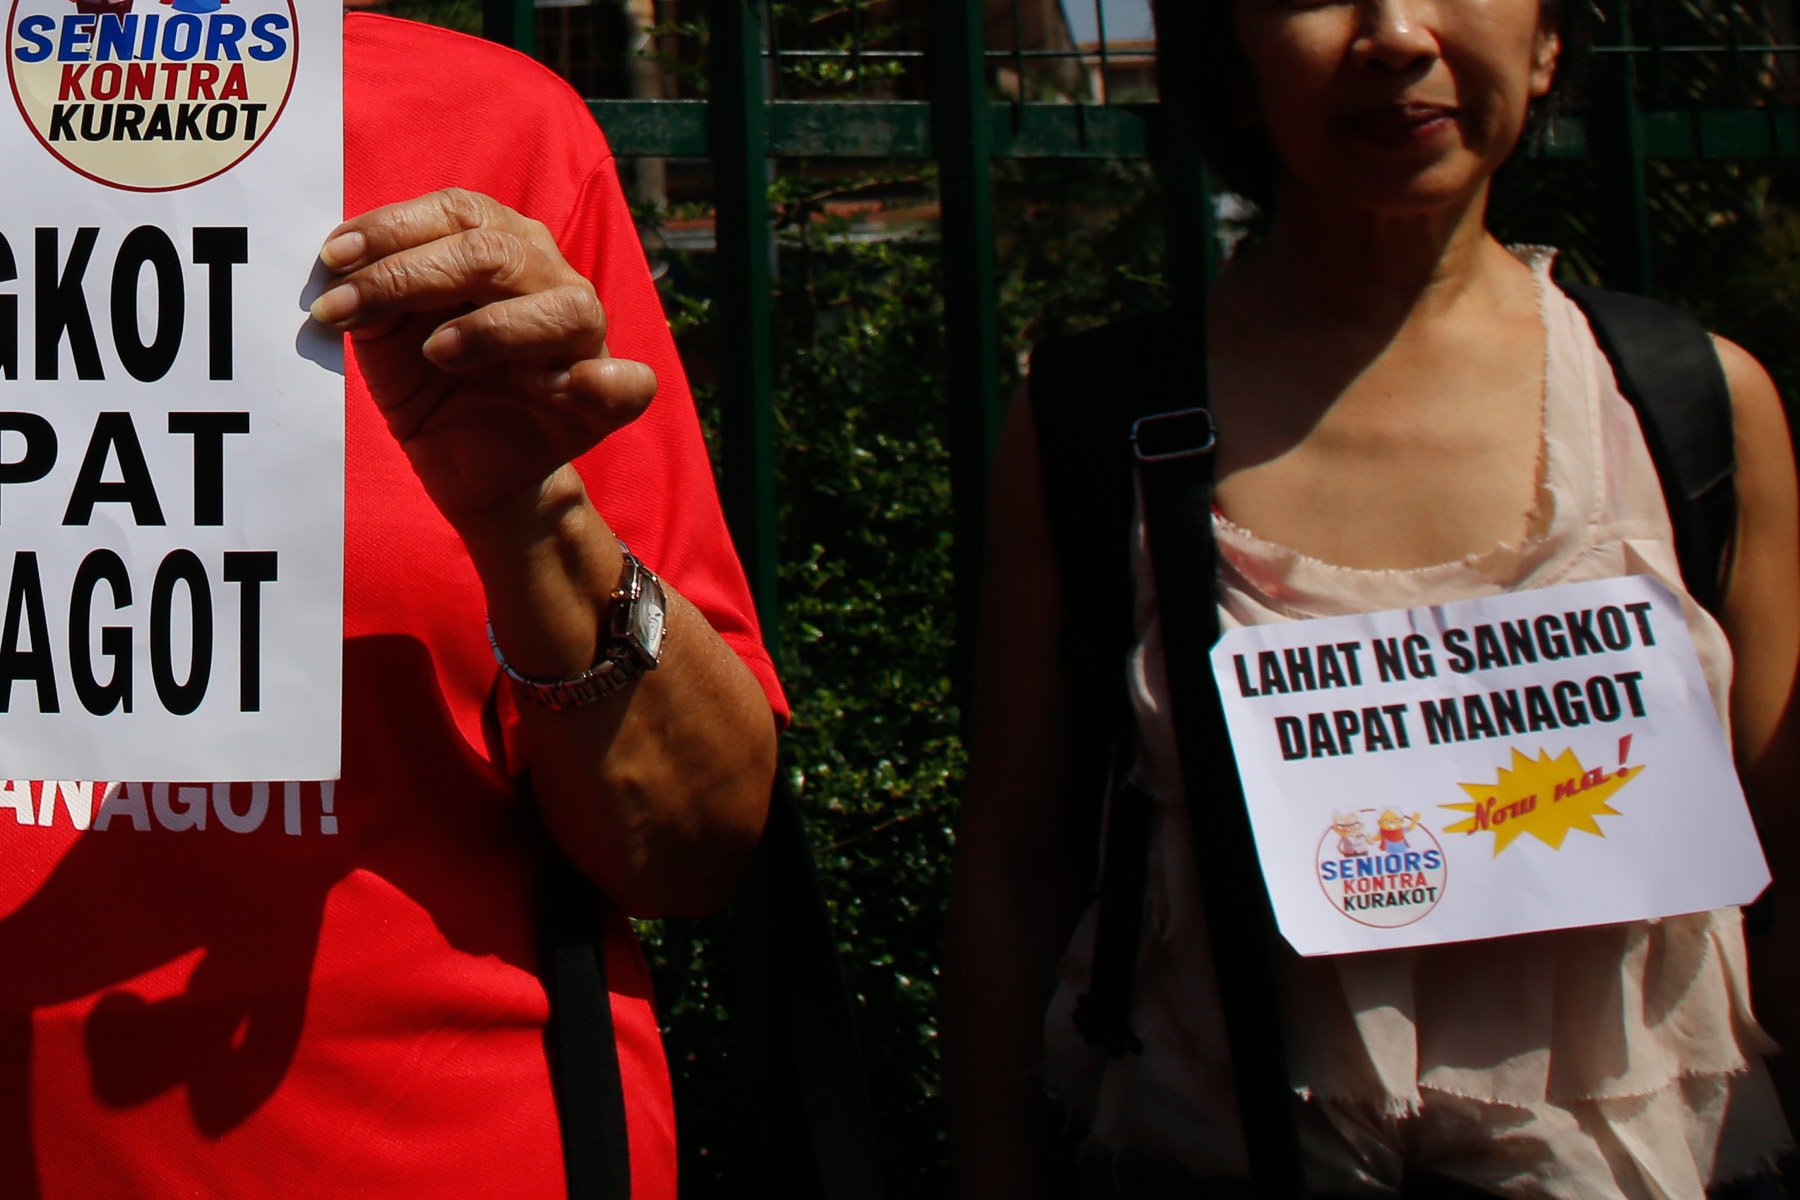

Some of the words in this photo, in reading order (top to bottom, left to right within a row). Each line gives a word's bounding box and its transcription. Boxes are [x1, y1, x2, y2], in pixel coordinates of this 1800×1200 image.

[14, 13, 290, 63] SENIORS
[57, 63, 250, 101] KONTRA
[48, 103, 267, 142] KURAKOT
[1233, 642, 1363, 698] LAHAT
[1373, 632, 1438, 683] NG
[1443, 601, 1659, 674] SANGKOT
[1274, 703, 1409, 761] DAPAT
[1420, 670, 1647, 746] MANAGOT
[1467, 795, 1538, 836] Now
[1553, 732, 1634, 804] na!
[1321, 848, 1442, 882] SENIORS
[1343, 871, 1428, 895] KONTRA
[1343, 886, 1438, 912] KURAKOT
